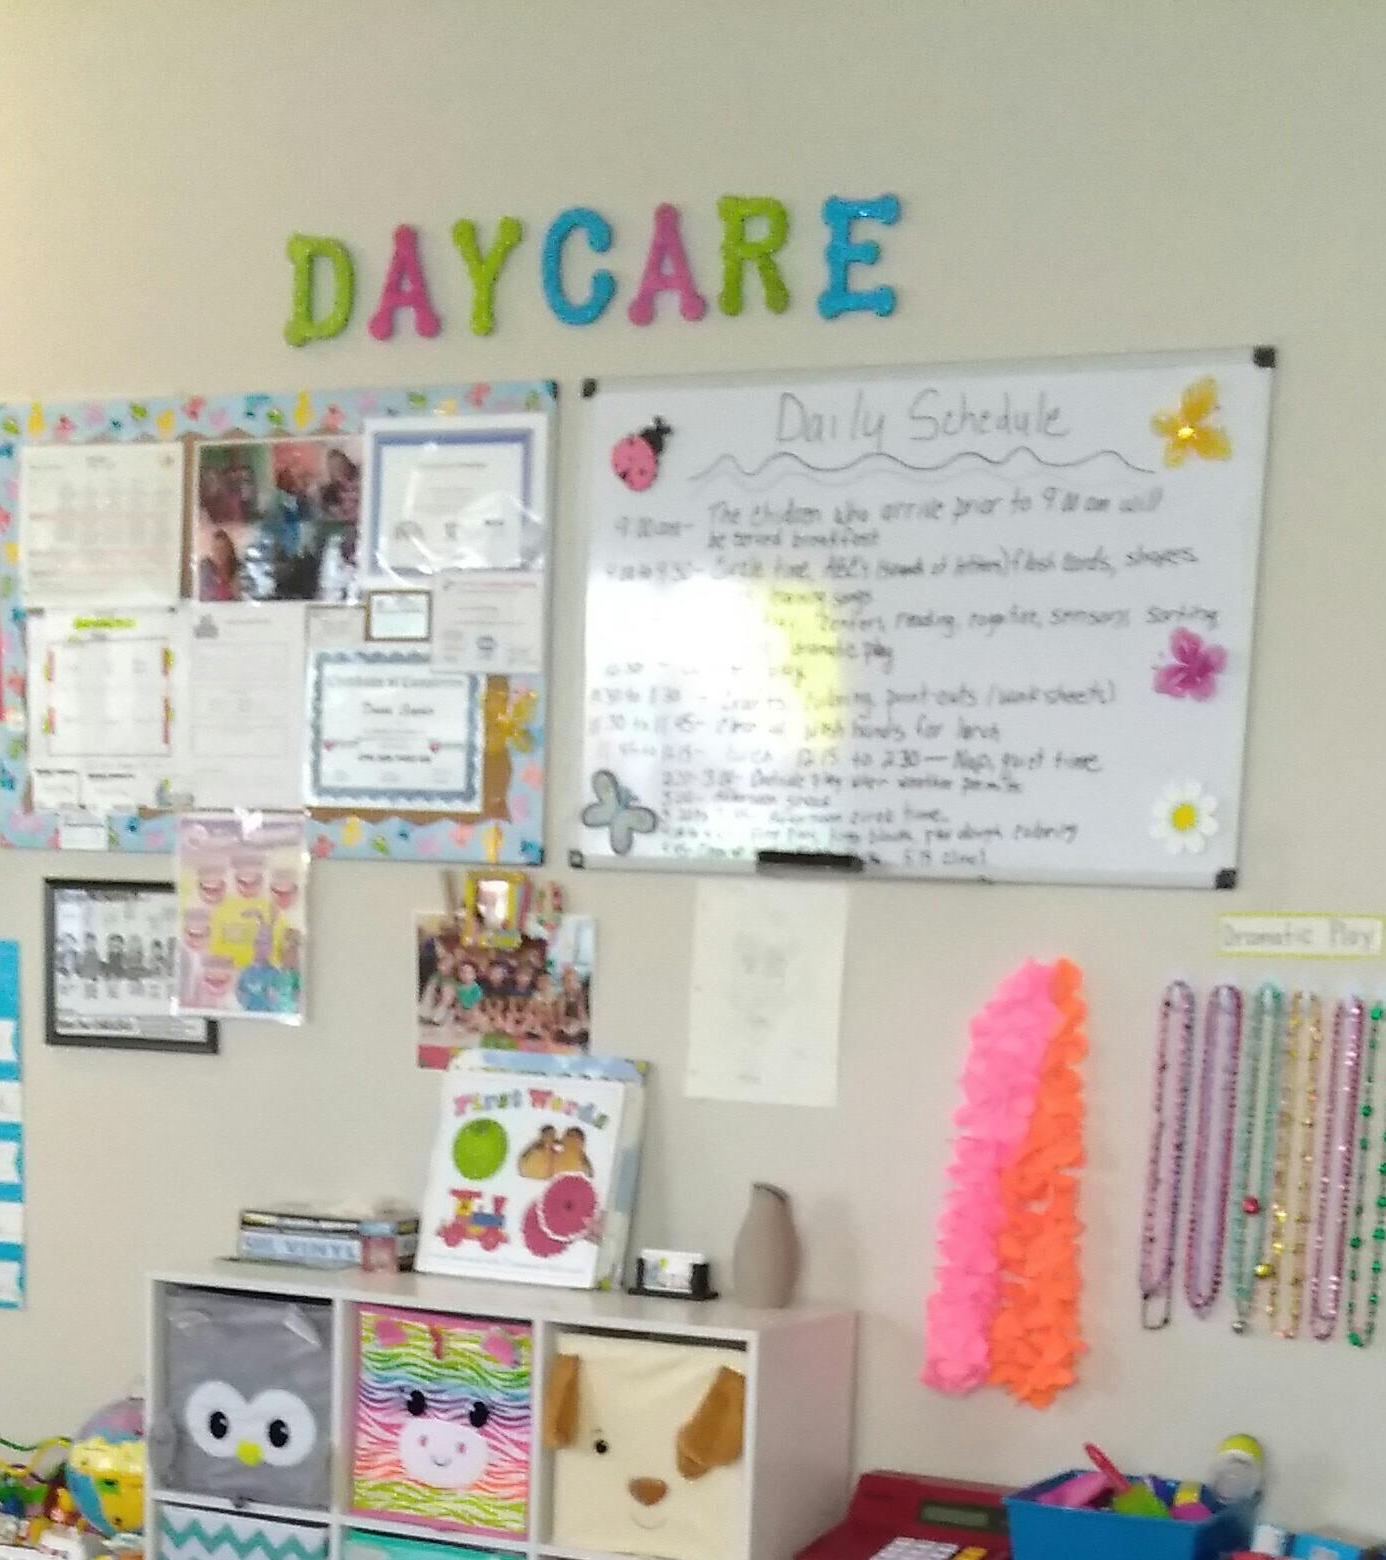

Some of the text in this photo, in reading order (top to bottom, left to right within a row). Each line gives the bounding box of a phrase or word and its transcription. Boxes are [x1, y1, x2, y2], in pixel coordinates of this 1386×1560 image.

[283, 193, 902, 348] DAYCARE
[776, 387, 1070, 453] Daily Schedule
